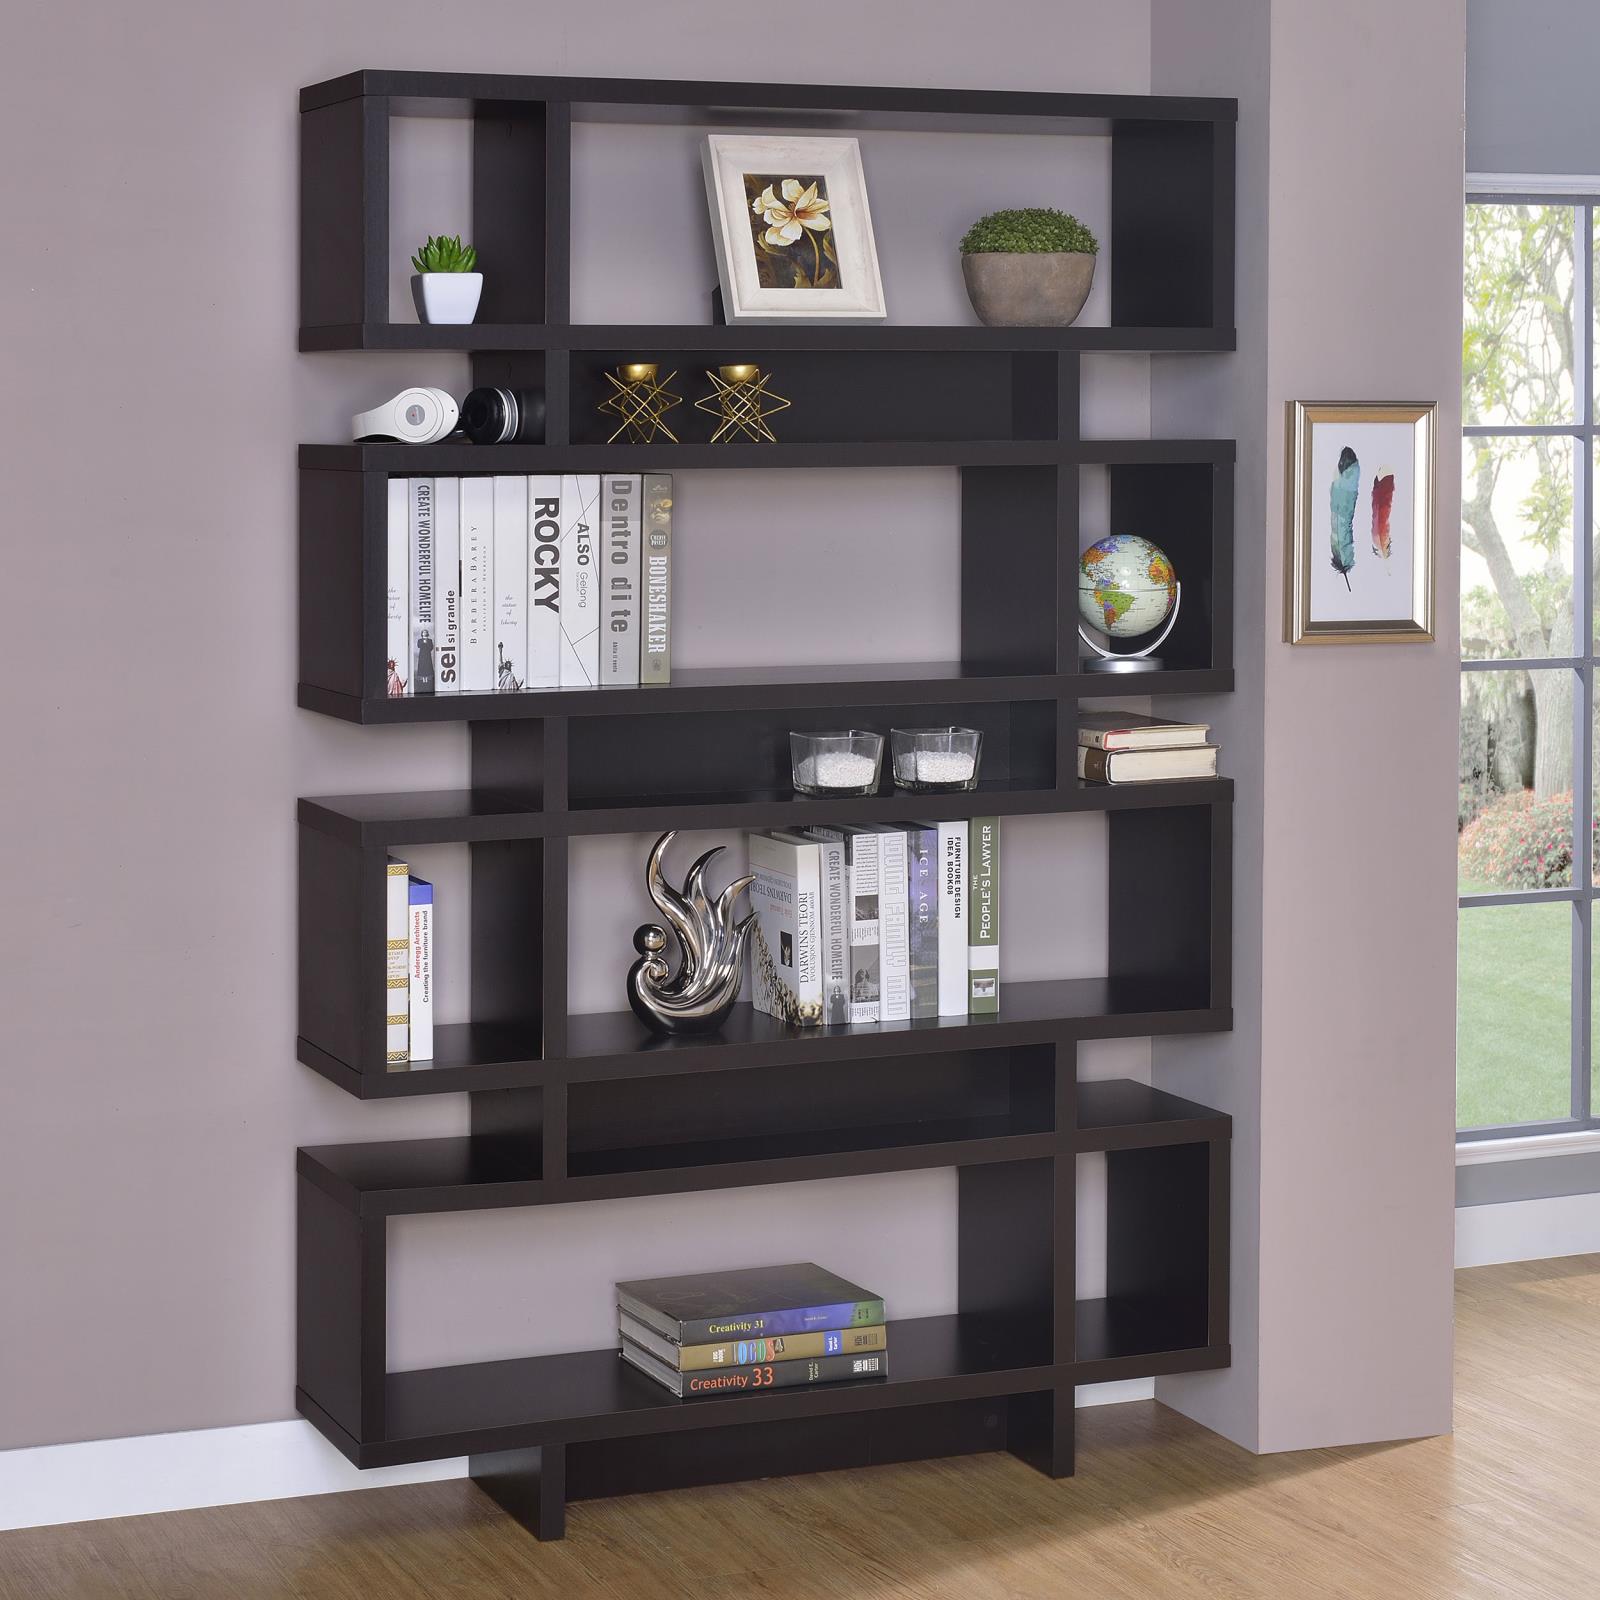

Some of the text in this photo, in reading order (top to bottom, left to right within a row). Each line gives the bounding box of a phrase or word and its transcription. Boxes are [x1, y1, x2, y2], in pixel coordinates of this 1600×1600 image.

[417, 484, 432, 624] CREATE WONDERFUL HOMELIFE
[533, 497, 560, 614] ROCKY
[576, 522, 590, 608] ALSO Gelang
[610, 480, 633, 633] Dentro di te
[435, 590, 458, 684] sei si grande
[648, 555, 668, 654] BONESHAKER
[828, 850, 843, 980] CREATE WONDERFUL HOMELIFE
[919, 849, 928, 924] ICE AGE
[980, 824, 992, 939] PEOPLE'S LAWYER
[413, 912, 421, 979] Anderegg Architects
[798, 892, 810, 984] DARWINS TEORI
[422, 973, 430, 1003] Creating
[709, 1319, 765, 1335] Creativity 31
[731, 1339, 776, 1365] LOGOS
[690, 1366, 774, 1393] Creativity 33
